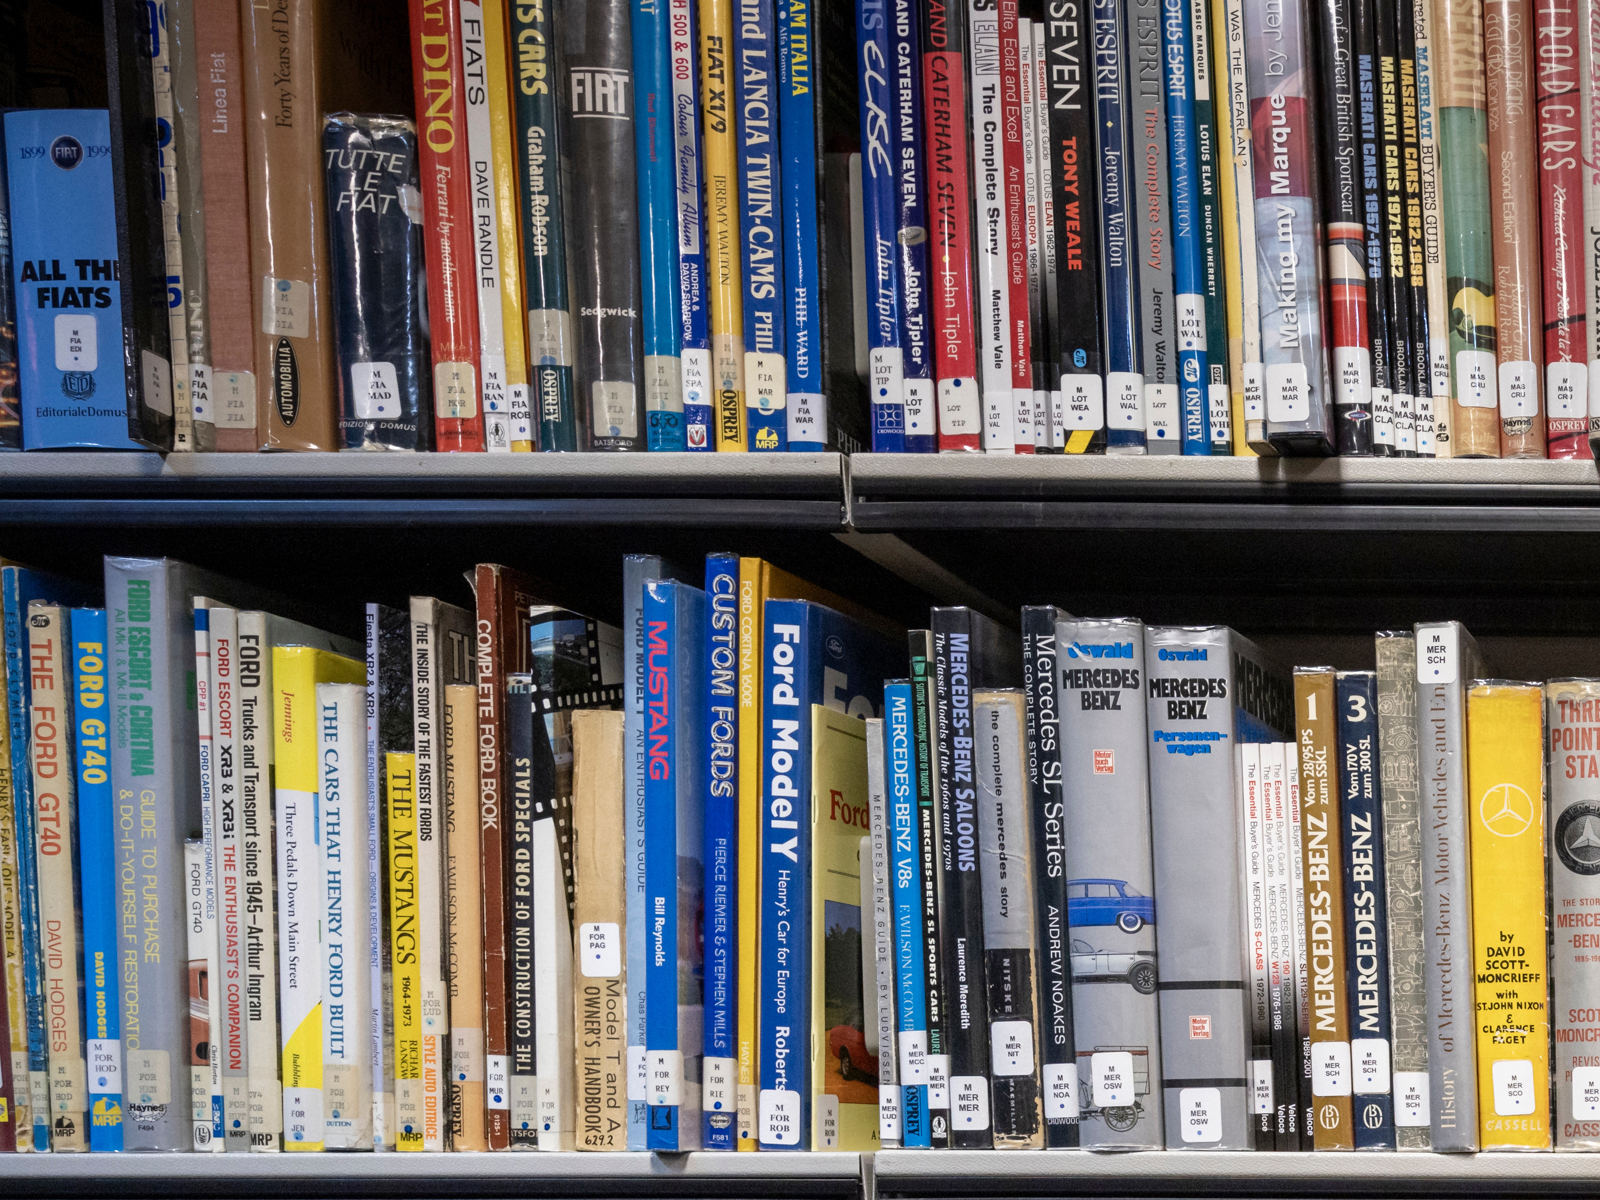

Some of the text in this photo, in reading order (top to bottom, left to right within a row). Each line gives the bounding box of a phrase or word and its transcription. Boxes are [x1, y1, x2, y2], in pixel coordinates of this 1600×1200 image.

[211, 52, 227, 133] Linea Fiat
[421, 33, 455, 153] DINO
[571, 73, 629, 114] FIAT
[707, 35, 726, 134] FIAT X1/9
[790, 34, 808, 96] ITALIA
[1022, 63, 1031, 104] Essential
[1539, 27, 1576, 170] ROAD CARS
[326, 149, 406, 173] TUTTE
[464, 19, 495, 288] FIATS DAVE RANDLE
[518, 28, 550, 256] CARS Graham Robson
[898, 45, 916, 207] CATERHAM SEVEN
[974, 21, 1000, 256] ELAN The Complete Story
[1050, 3, 1082, 270] SEVEN TONY WEALE
[1096, 19, 1126, 267] ESPRIT Jeremy Walton
[1335, 49, 1354, 214] Great British Sportscar
[336, 192, 396, 212] FIAT
[349, 172, 382, 190] LE
[742, 49, 776, 300] LANCIA TWIN-CAMS
[1027, 173, 1035, 202] LOTUS
[1265, 49, 1298, 348] Making my Marque by
[1359, 55, 1381, 278] MASERATI CARS 1957-1970
[1028, 205, 1037, 245] EUROPA
[1200, 125, 1215, 296] LOTUS ELAN DUNCAN WHERRETT
[21, 261, 66, 282] ALL
[37, 287, 112, 308] FIATS
[581, 307, 637, 318] Sedgwick
[992, 290, 1003, 369] Matthew Vale
[278, 347, 292, 417] AUTOMOBILIA
[756, 440, 778, 448] MRP
[710, 574, 735, 798] CUSTOM FORDS
[1150, 678, 1227, 698] MERCEDES
[1158, 649, 1207, 661] Oswald
[1428, 656, 1445, 664] SCH
[282, 691, 293, 743] Jennings
[416, 624, 432, 841] THE INSIDE STORY OF THE FASTEST FORDS
[1154, 731, 1227, 742] Personen-
[1167, 744, 1211, 756] wagen
[1168, 701, 1207, 719] BENZ
[892, 696, 912, 888] MERCEDES-BENZ V8s
[950, 633, 975, 872] MERCEDES-BENZ SALOONS
[992, 735, 1003, 797] complete
[649, 621, 669, 967] MUSTANG Bill Reynolds
[771, 624, 800, 1014] Ford Model Y Henry's Car for Europe
[79, 642, 107, 1038] FORD GT40 DAVID HODGES
[218, 639, 242, 1069] FORD ESCORT XR3 & XR3i THE ENTHUSIAST'S COMPANION
[996, 803, 1006, 880] mercedes
[1036, 634, 1065, 1044] Mercedes SL Series ANDREW NOAKES
[286, 803, 299, 989] Three Pedals Down Main Street
[323, 702, 344, 1058] THE CARS THAT HENRY FORD BUILT
[515, 758, 531, 1071] THE CONSTRUCTION OF FORD SPECIALS
[1000, 887, 1009, 918] story
[1308, 812, 1336, 1032] MERCEDES-BENZ
[1351, 812, 1379, 1032] MERCEDES-BENZ
[1487, 947, 1525, 957] DAVID
[958, 938, 970, 1029] Laurence Meredith
[1255, 931, 1265, 1020] S-CLASS 1972-1980
[1478, 974, 1540, 983] MONCRIEFF
[1486, 960, 1529, 970] SCOTT-
[93, 1117, 122, 1126] MRP
[1441, 1066, 1459, 1128] History
[1486, 1120, 1542, 1131] CASSELL
[585, 1135, 613, 1145] 629.2
